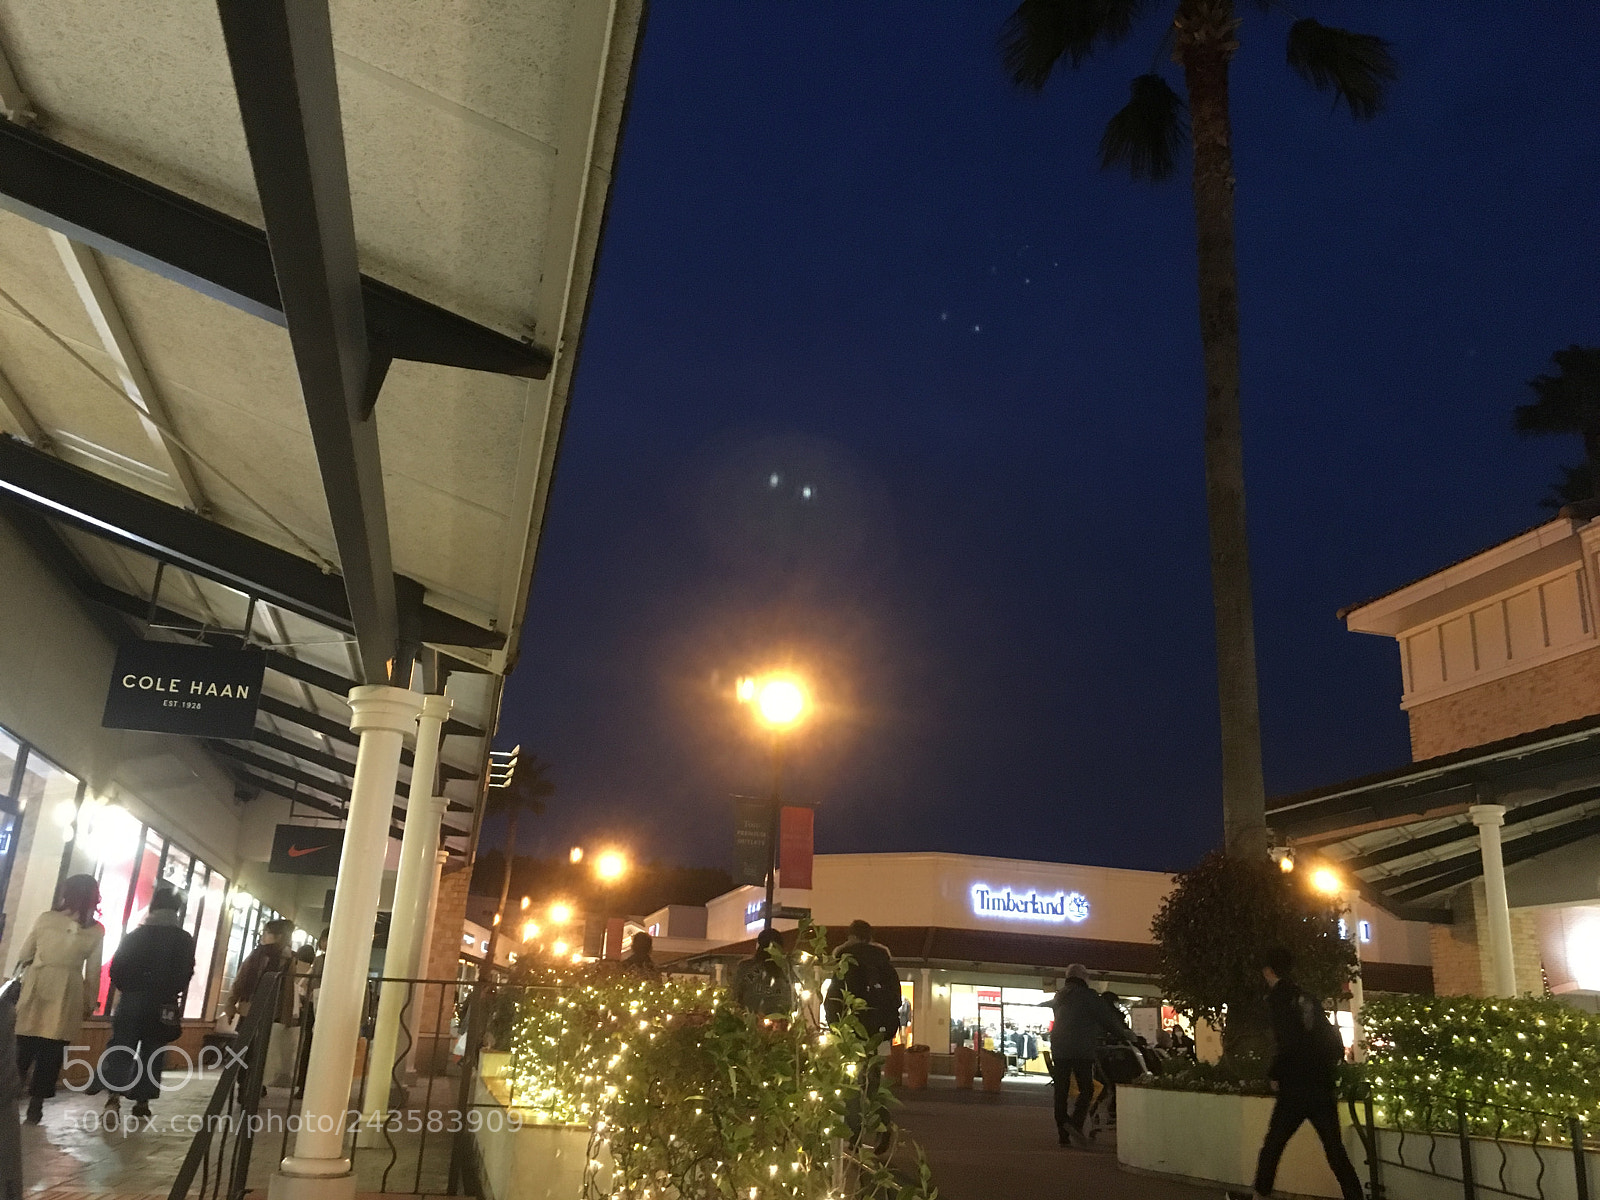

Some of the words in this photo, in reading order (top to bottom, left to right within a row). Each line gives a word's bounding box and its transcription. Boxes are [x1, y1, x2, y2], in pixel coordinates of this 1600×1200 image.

[122, 674, 181, 693] COLE
[189, 680, 250, 699] HAAN
[976, 889, 1065, 916] Timberland
